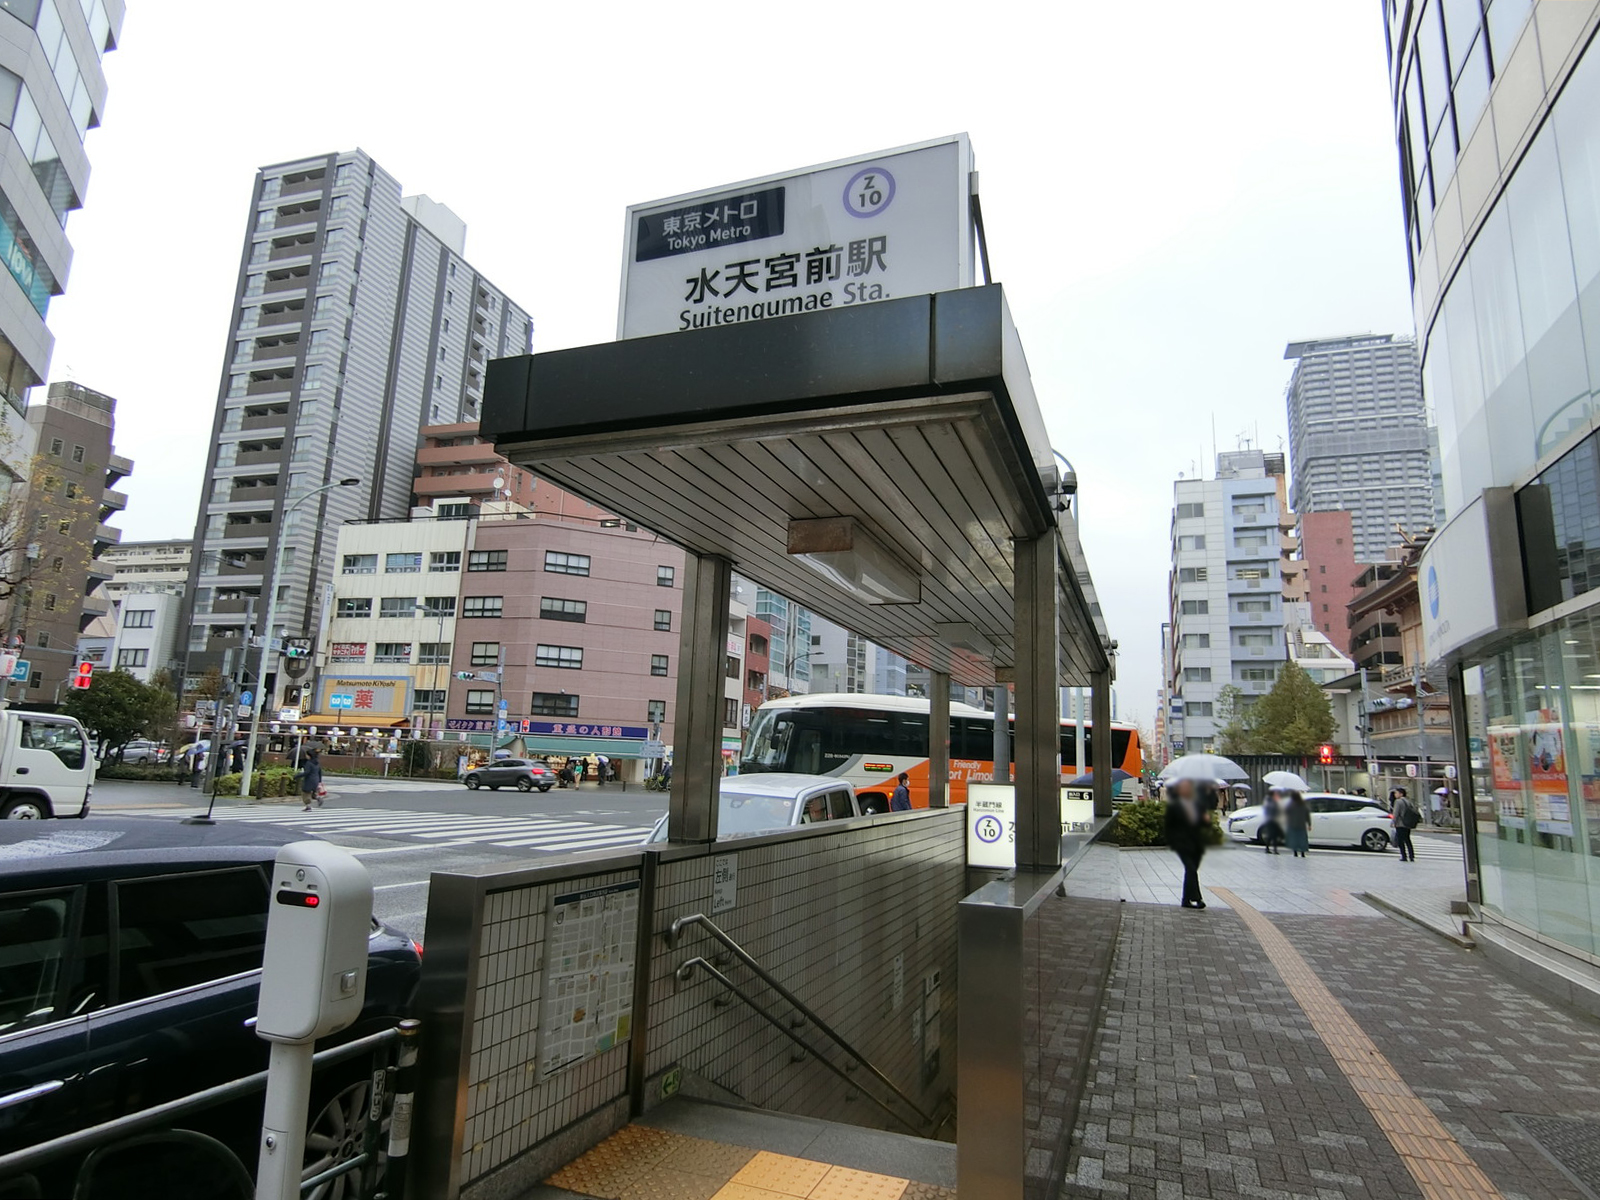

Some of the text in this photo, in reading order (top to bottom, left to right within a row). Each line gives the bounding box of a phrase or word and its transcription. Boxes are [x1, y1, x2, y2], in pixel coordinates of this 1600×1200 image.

[863, 175, 875, 191] Z
[858, 190, 883, 208] 10
[662, 200, 758, 237] 東京メトロ
[667, 224, 751, 252] Tokyo Metro
[685, 235, 888, 305] 水天宮前駅
[842, 281, 891, 305] Sta.
[354, 689, 375, 709] 薬
[953, 760, 981, 770] Friendly
[1083, 792, 1090, 800] 6
[986, 819, 992, 828] Z
[983, 828, 996, 838] 10
